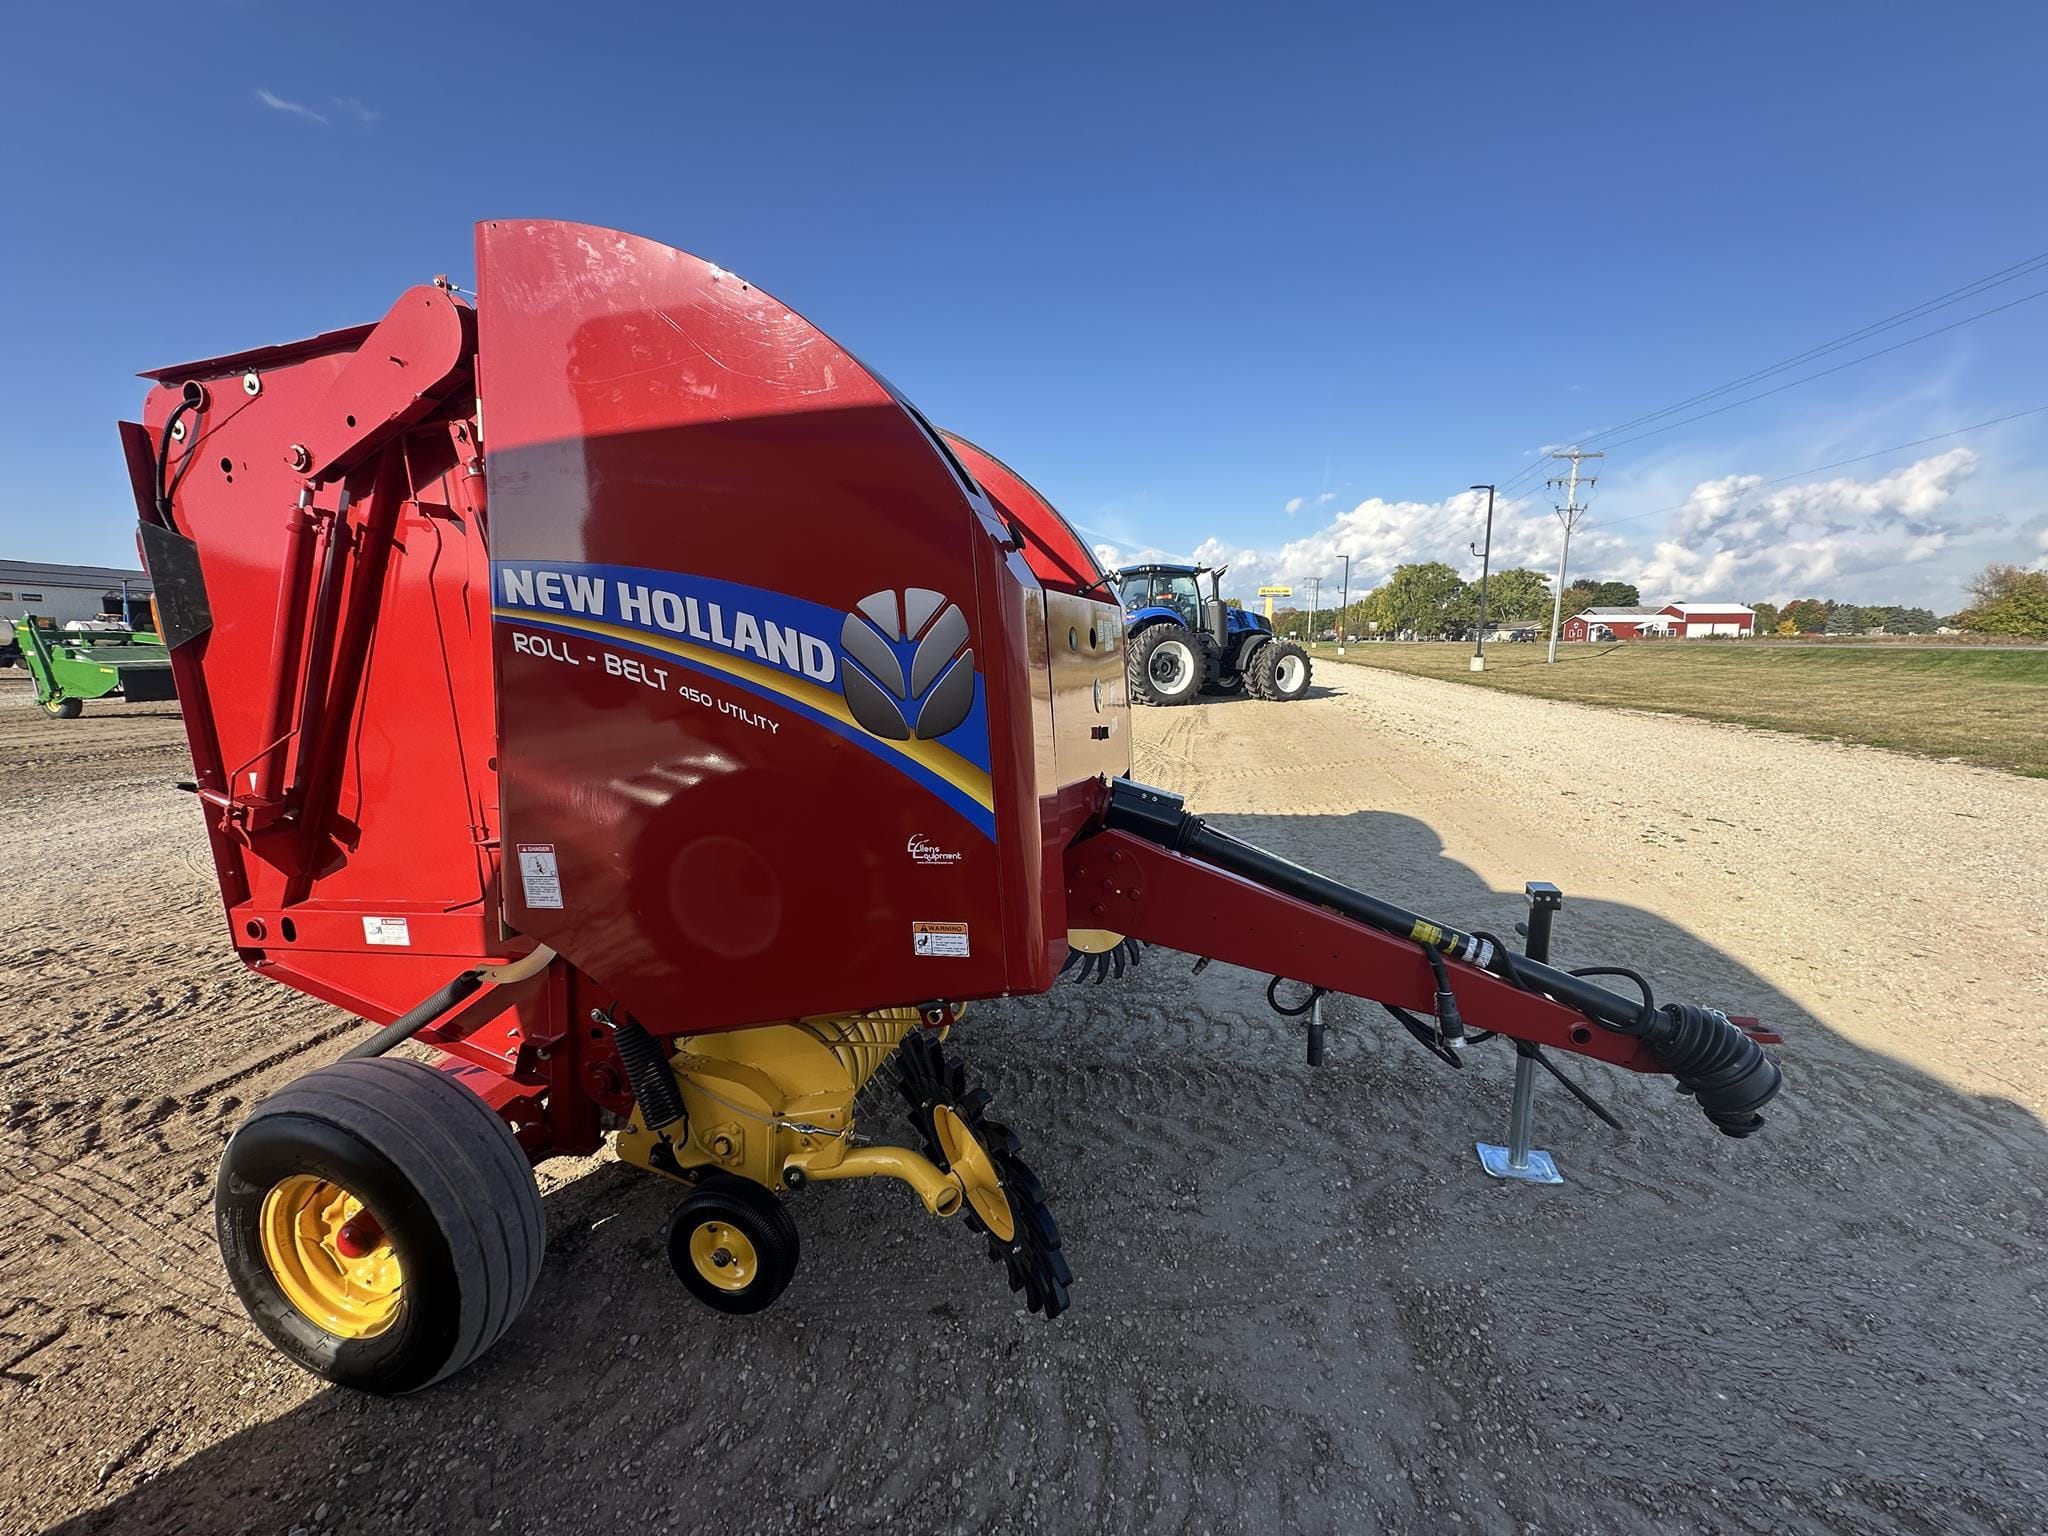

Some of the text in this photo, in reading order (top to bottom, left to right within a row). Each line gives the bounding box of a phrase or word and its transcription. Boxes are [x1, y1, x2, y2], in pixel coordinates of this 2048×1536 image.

[502, 568, 836, 683] NEW HOLLAND
[512, 632, 579, 665] ROLL
[603, 652, 669, 691] BELT
[679, 686, 780, 734] 450 UTILITY
[907, 833, 940, 852] Ellens
